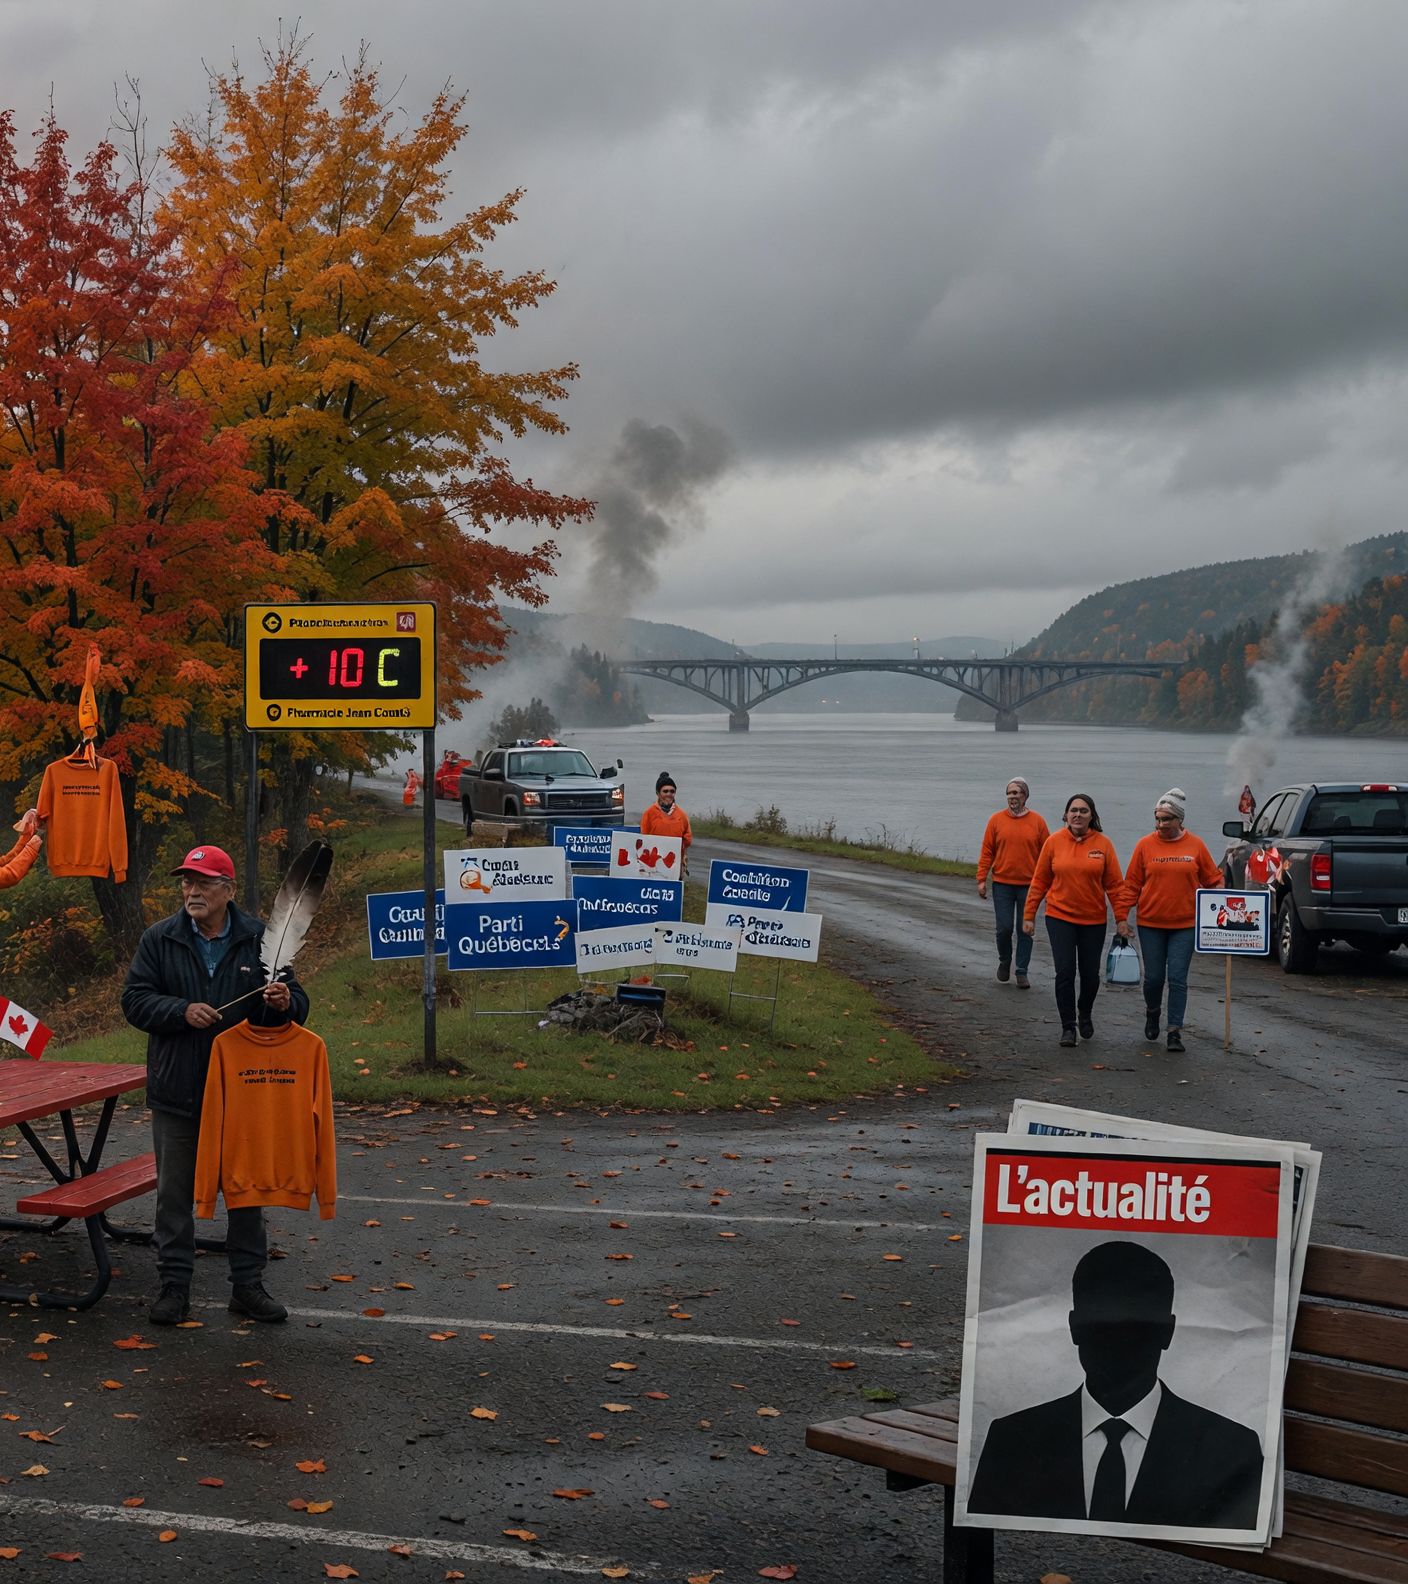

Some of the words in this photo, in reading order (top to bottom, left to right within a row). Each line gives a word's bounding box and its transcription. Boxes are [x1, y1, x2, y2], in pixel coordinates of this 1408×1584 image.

[328, 648, 365, 688] 10
[377, 648, 401, 687] C
[478, 915, 524, 934] Parti
[996, 1163, 1212, 1224] L'actualité
